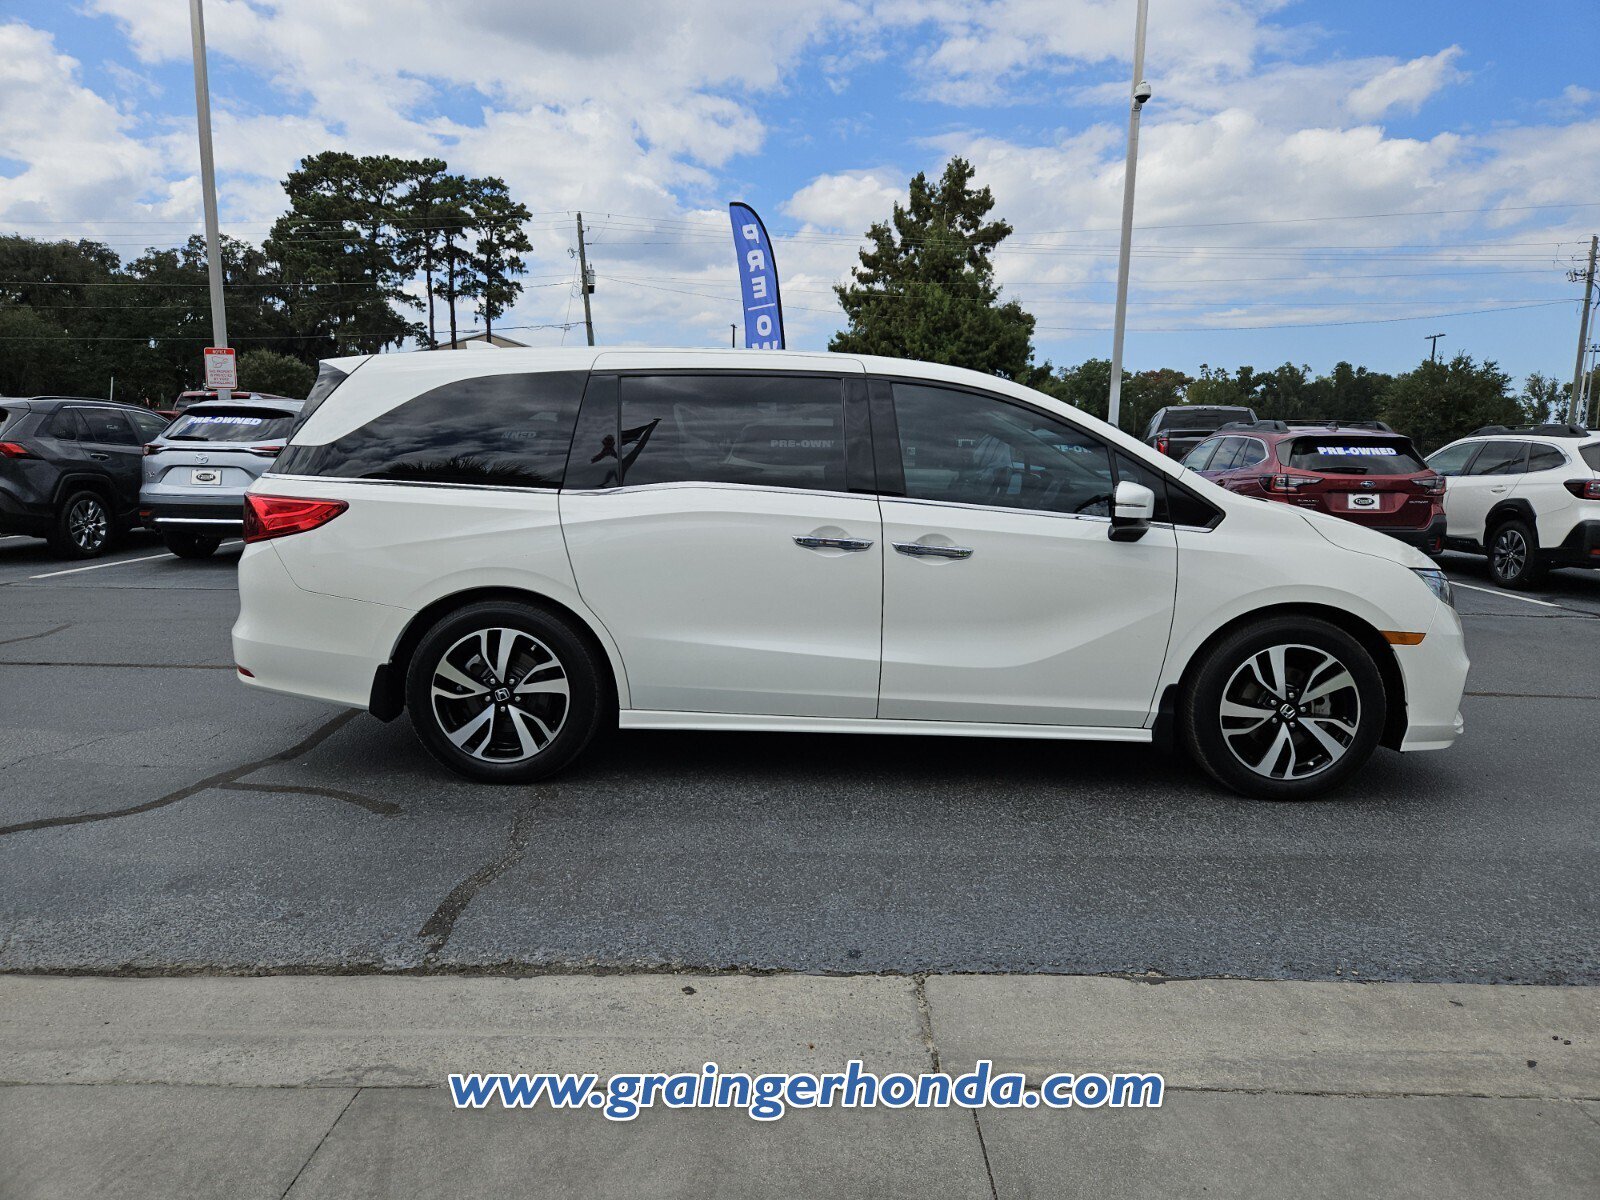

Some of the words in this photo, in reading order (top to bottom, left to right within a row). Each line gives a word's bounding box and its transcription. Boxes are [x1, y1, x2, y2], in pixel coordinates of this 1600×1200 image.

[187, 416, 262, 426] PRE-OWNED
[770, 439, 834, 448] PRE-OWN
[1316, 446, 1397, 456] PRE-OWNED
